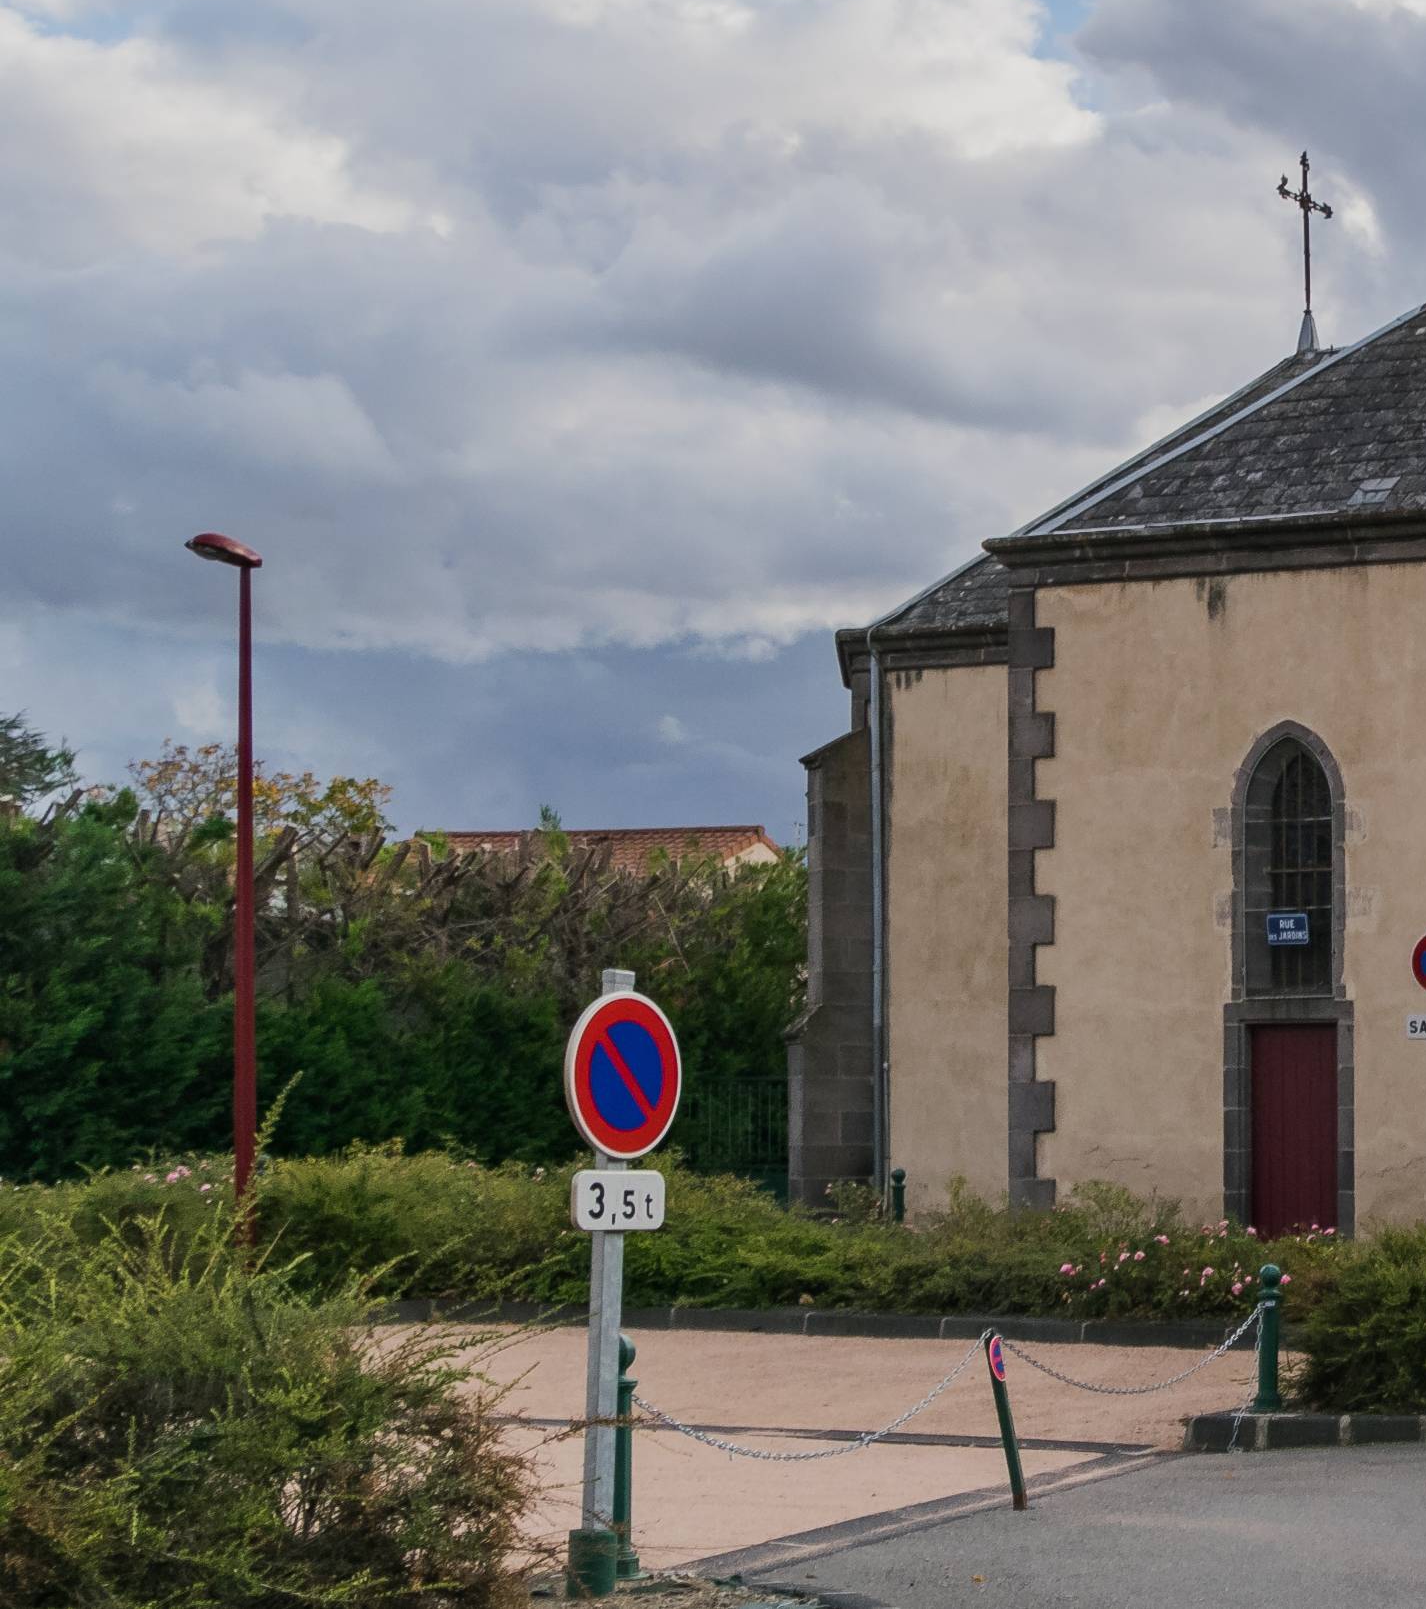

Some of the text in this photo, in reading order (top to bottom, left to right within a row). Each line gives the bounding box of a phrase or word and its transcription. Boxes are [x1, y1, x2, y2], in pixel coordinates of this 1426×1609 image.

[1280, 919, 1295, 929] RUE
[1278, 931, 1307, 941] JARDINS
[588, 1182, 654, 1225] 3,5 t
